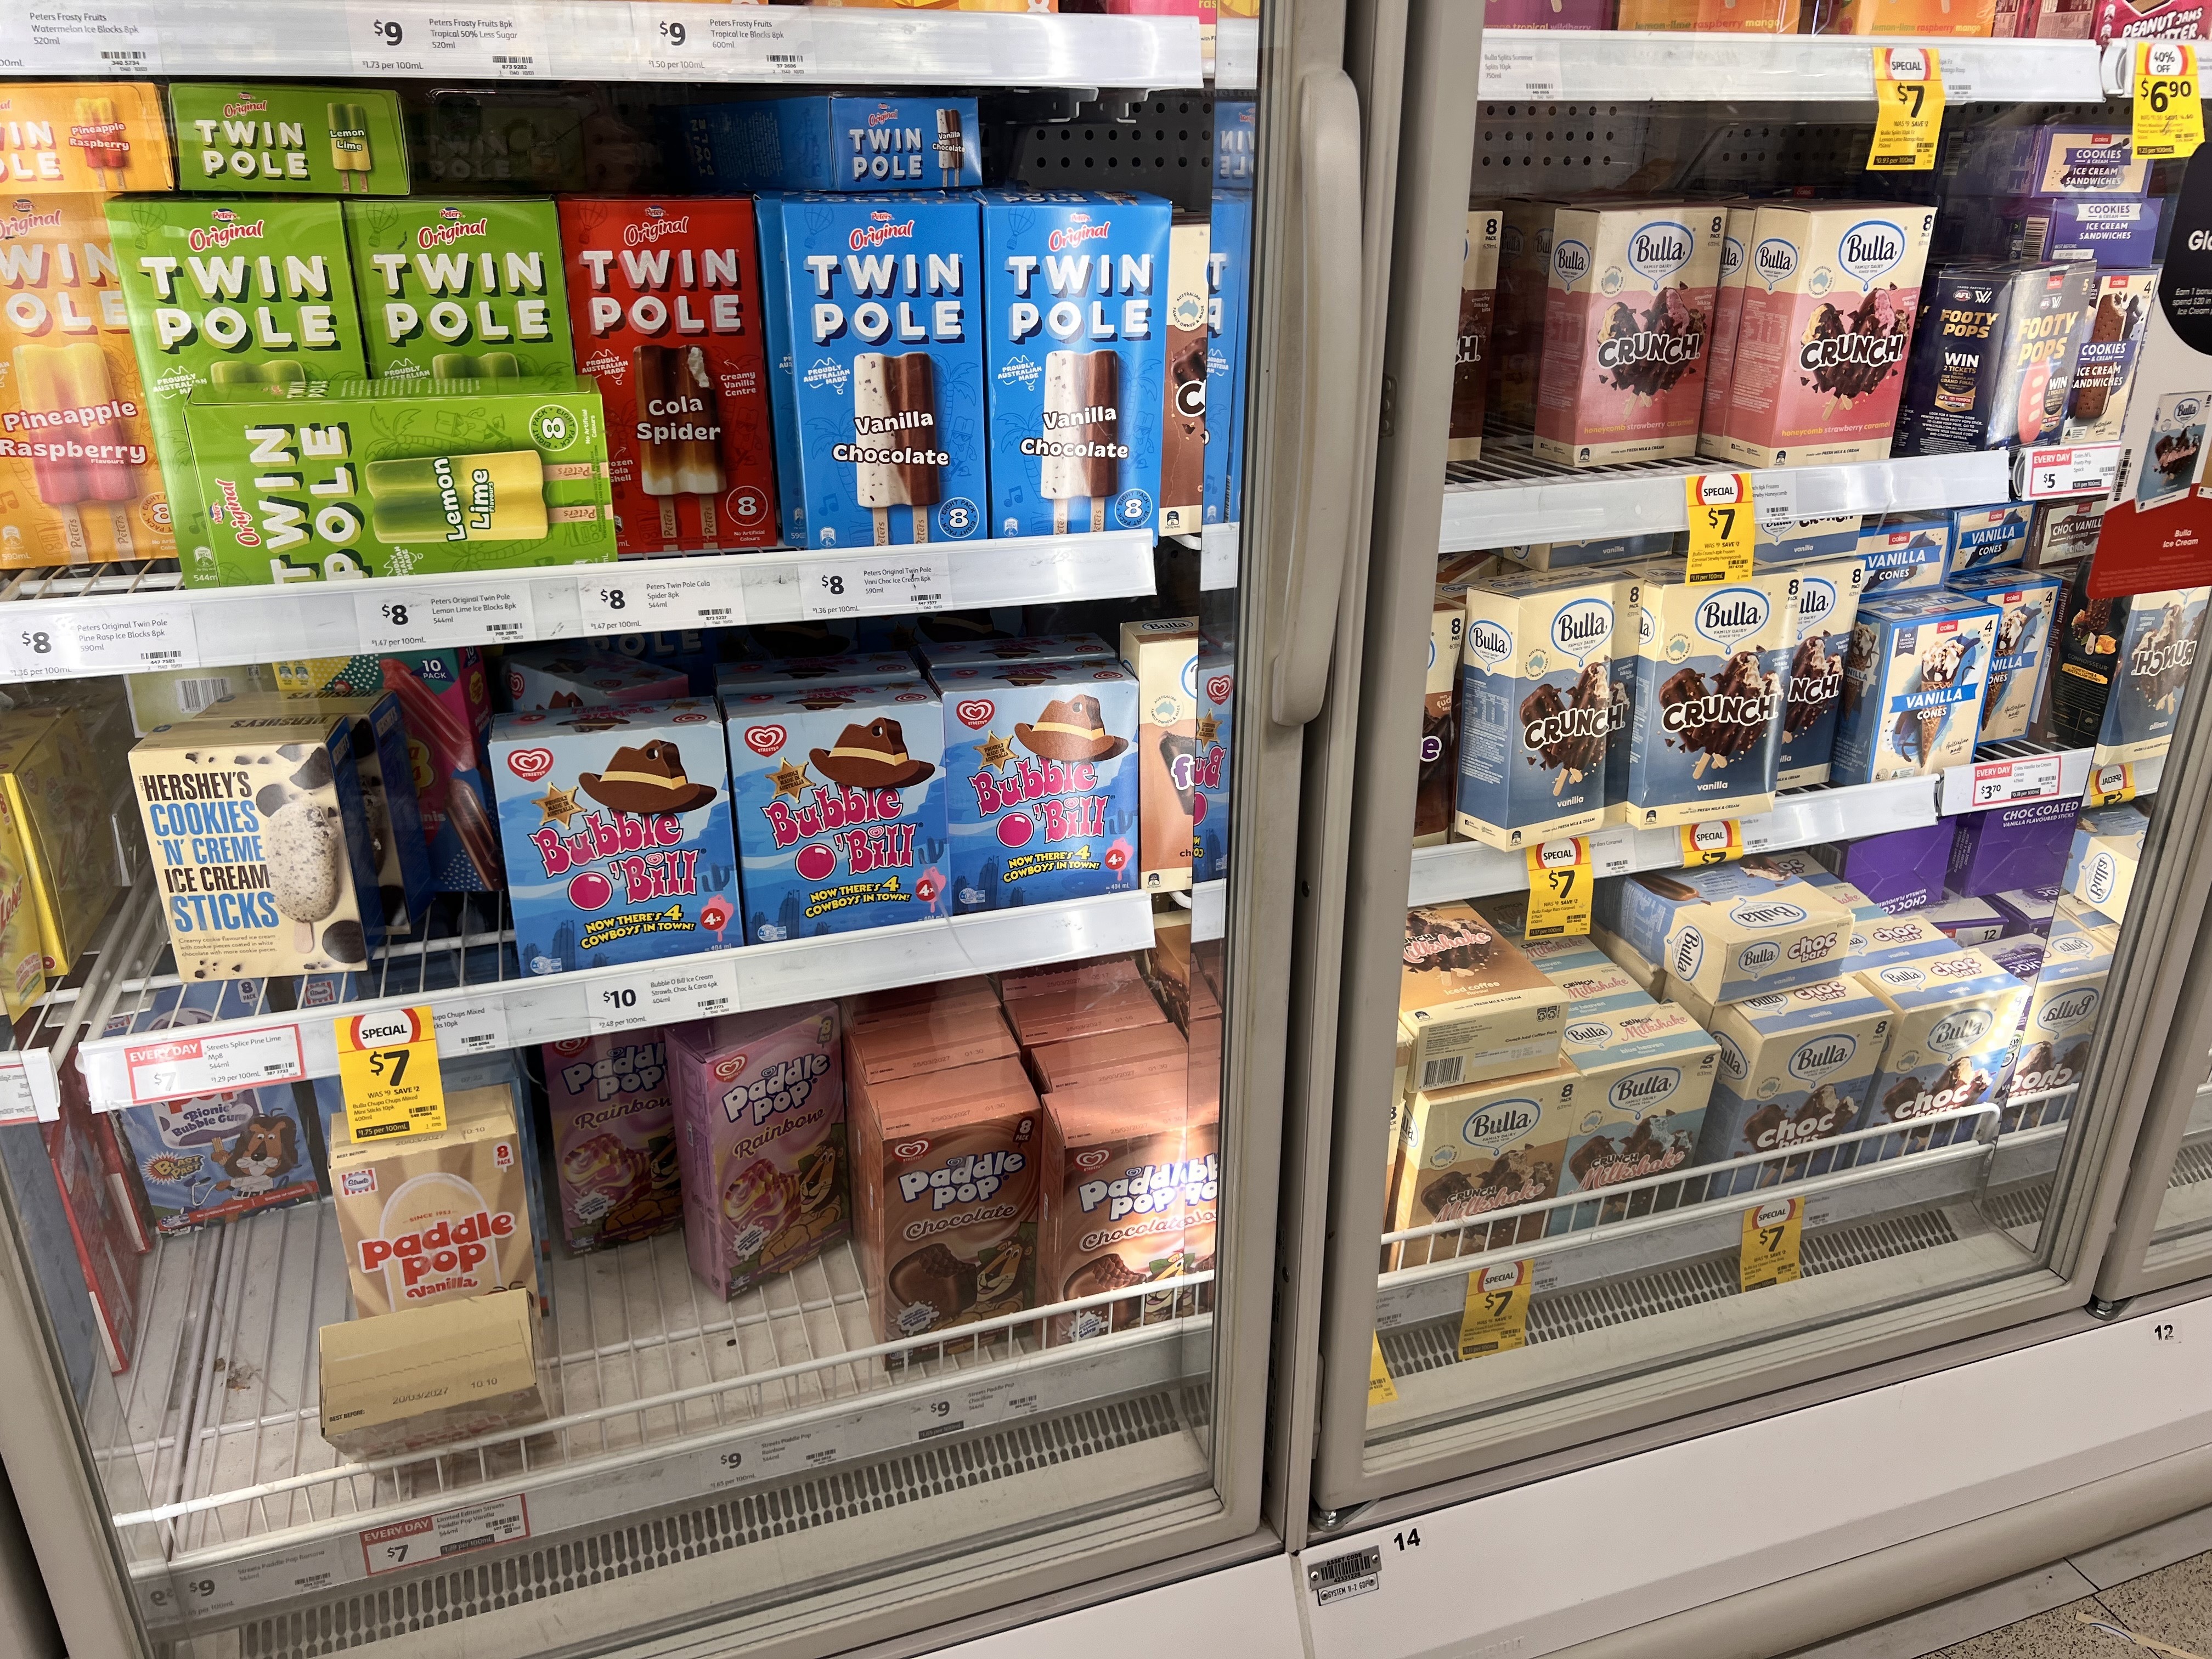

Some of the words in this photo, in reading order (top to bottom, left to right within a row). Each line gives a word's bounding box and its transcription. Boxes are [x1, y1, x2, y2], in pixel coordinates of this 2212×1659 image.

[30, 13, 55, 21] Peters
[57, 13, 82, 23] Frosty
[84, 13, 106, 21] Fruits
[454, 19, 476, 29] Frosty
[499, 20, 512, 29] 8pk
[31, 25, 83, 33] Watermelon
[97, 25, 123, 33] Blocks
[124, 25, 139, 36] 8pk
[374, 19, 403, 46] $9
[432, 30, 460, 39] Tropical
[496, 31, 517, 40] Sugar
[659, 21, 686, 46] $9
[33, 37, 60, 45] 520ml
[1892, 61, 1922, 70] SPECIAL
[2154, 51, 2175, 63] 40%
[2157, 65, 2171, 73] OFF
[1897, 82, 1925, 118] $7
[195, 119, 304, 146] TWIN
[205, 151, 308, 177] POLE
[2076, 149, 2121, 159] COOKIES
[2066, 177, 2121, 185] SANDWICHES
[849, 221, 915, 251] Original
[1847, 234, 1897, 262] Bulla
[140, 255, 328, 298] TWIN
[583, 250, 738, 287] TWIN
[808, 256, 960, 290] TWIN
[592, 295, 742, 334] POLE
[816, 302, 961, 338] POLE
[1939, 309, 2000, 324] FOOTY
[155, 305, 336, 349] POLE
[1942, 323, 1990, 338] POPS
[1799, 332, 1903, 371] CRUNCH
[1944, 352, 1979, 368] WIN
[582, 360, 629, 375] AUSTRALIAN
[585, 356, 620, 368] PROUDLY
[604, 367, 626, 376] MADE
[720, 372, 756, 382] Creamy
[725, 387, 757, 397] Centre
[2, 400, 138, 432] Pineapple
[648, 397, 704, 416] Cola
[855, 411, 934, 436] Vanilla
[1781, 426, 1823, 438] honeycomb
[1824, 423, 1863, 435] strawberry
[1864, 420, 1891, 430] caramel
[637, 424, 721, 444] Spider
[0, 439, 146, 464] Raspberry
[832, 443, 949, 466] Chocolate
[2034, 455, 2056, 464] EVERY
[2057, 453, 2070, 461] DAY
[2044, 473, 2056, 489] $5
[435, 456, 467, 542] Lemon
[469, 468, 490, 530] Lime
[1703, 487, 1734, 496] SPECIAL
[1708, 507, 1735, 540] $7
[2174, 528, 2192, 538] Bulla
[1971, 526, 2016, 546] VANILLA
[2163, 539, 2175, 548] Ice
[2176, 538, 2199, 548] Cream
[1978, 543, 2002, 556] CONES
[600, 589, 625, 609] $8
[382, 604, 409, 625] $8
[1704, 601, 1761, 628] Bulla
[77, 624, 100, 632] Peters
[102, 622, 131, 631] Original
[97, 634, 114, 642] Rasp
[152, 629, 165, 638] 8pk
[22, 631, 52, 653] $8
[1905, 687, 1963, 707] VANILLA
[1661, 693, 1779, 734] CRUNCH
[1916, 707, 1948, 720] CONES
[1976, 769, 1996, 777] EVERY
[1997, 766, 2011, 774] DAY
[142, 771, 253, 803] HERSHEY'S
[1696, 781, 1729, 792] vanilla
[150, 800, 259, 837] COOKIES
[2002, 806, 2033, 822] CHOC
[2035, 801, 2079, 817] COATED
[194, 836, 265, 864] CREME
[531, 811, 684, 877] Bubble
[1543, 850, 1573, 860] SPECIAL
[165, 867, 197, 893] ICE
[200, 864, 271, 891] CREAM
[1548, 870, 1575, 899] $7
[174, 891, 279, 933] STICKS
[585, 918, 614, 934] NOW
[617, 912, 662, 928] THERE'S
[664, 905, 683, 919] 4
[580, 925, 641, 949] COWBOYS
[642, 923, 653, 933] IN
[654, 921, 695, 932] TOWN!
[603, 989, 636, 1008] $10
[362, 1024, 407, 1039] SPECIAL
[129, 1048, 171, 1063] EVERY
[173, 1043, 198, 1056] DAY
[207, 1042, 229, 1051] Streets
[231, 1040, 249, 1048] Splice
[250, 1038, 265, 1046] Pine
[210, 1061, 229, 1069] 544ml
[369, 1049, 410, 1087] $7
[394, 1087, 413, 1095] SAVE
[1472, 1110, 1532, 1139] Bulla
[1757, 1113, 1835, 1149] choc
[1432, 1181, 1546, 1224] Milkshake
[904, 1204, 1017, 1235] Chocolate
[1758, 1208, 1786, 1222] SPECIAL
[358, 1210, 515, 1273] paddle
[1759, 1227, 1784, 1252] $7
[401, 1243, 487, 1286] pop
[406, 1277, 477, 1300] Vanilla
[1485, 1272, 1514, 1285] SPECIAL
[1485, 1290, 1513, 1317] $7
[2154, 1324, 2174, 1341] 12
[720, 1453, 742, 1469] $9
[364, 1526, 403, 1542] EVERY
[405, 1518, 430, 1532] DAY
[1393, 1528, 1421, 1551] 14
[387, 1544, 409, 1562] $7
[1327, 1558, 1345, 1566] ASSET
[1346, 1552, 1362, 1560] CODE
[1334, 1572, 1361, 1583] 42331228
